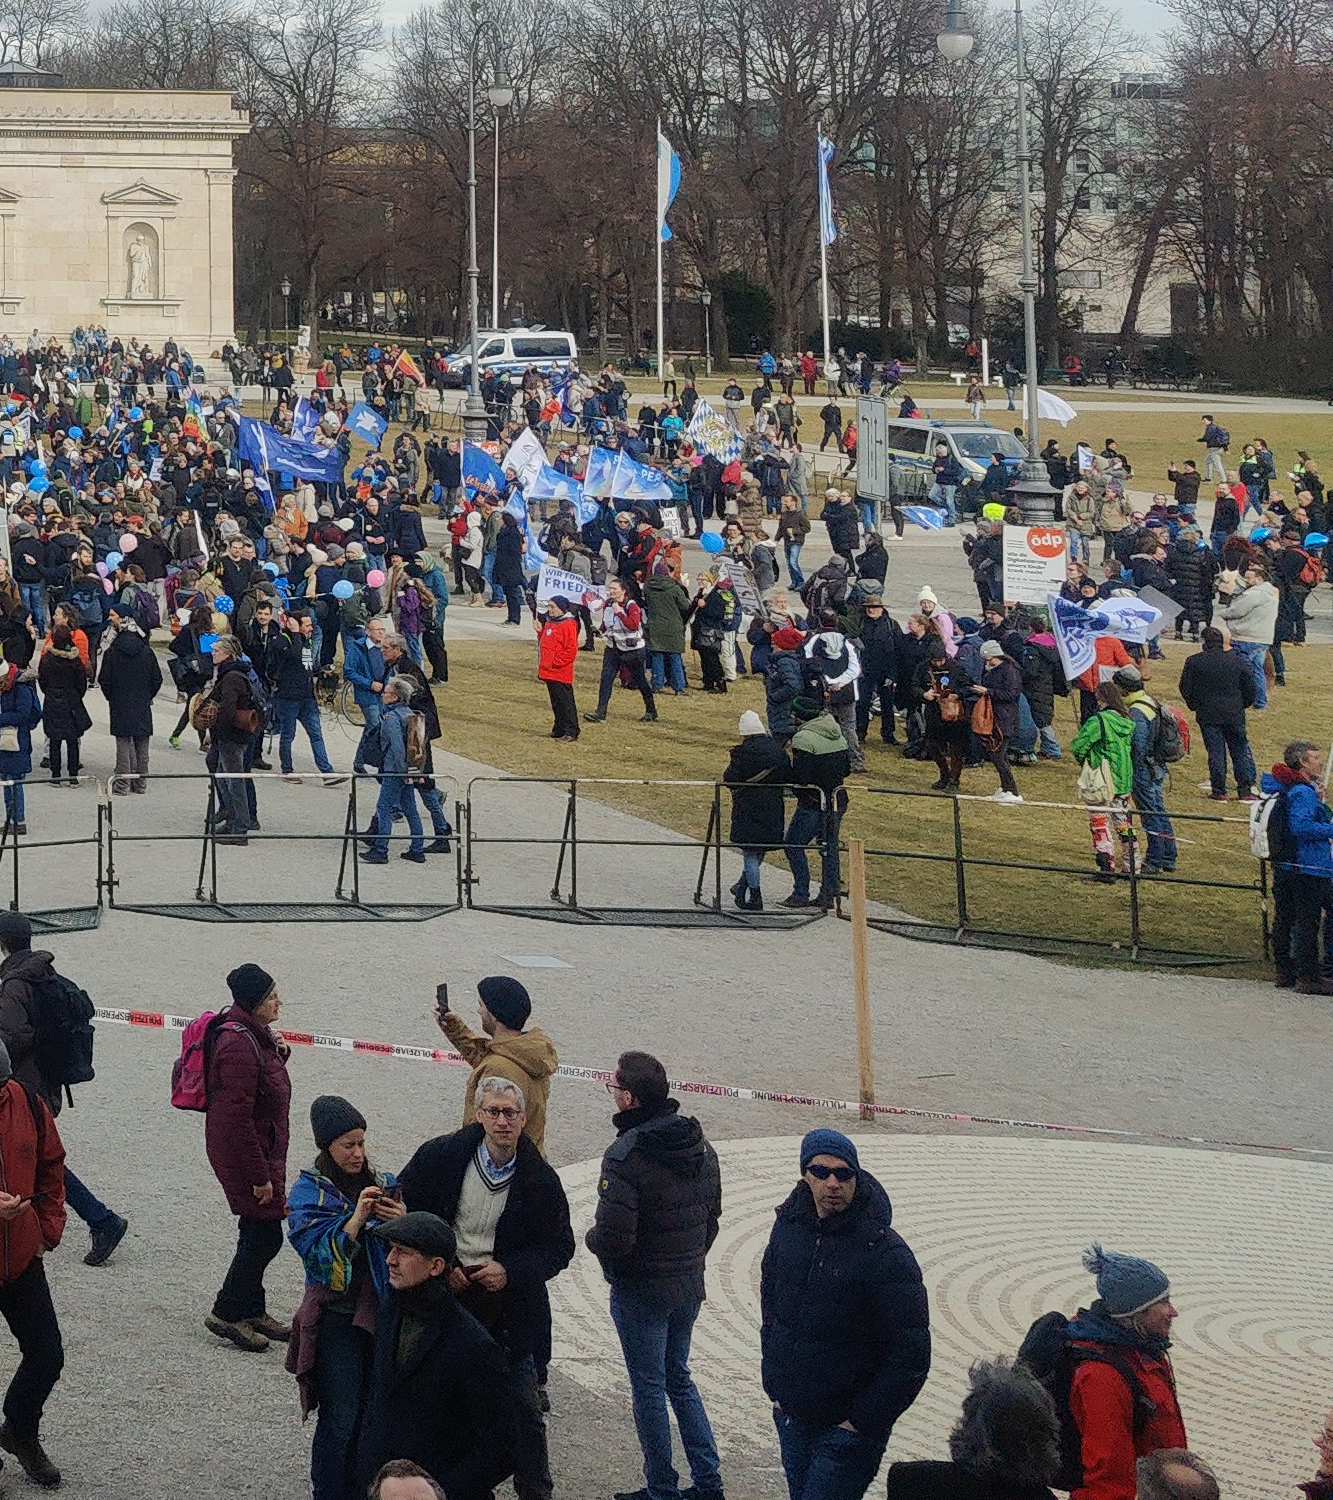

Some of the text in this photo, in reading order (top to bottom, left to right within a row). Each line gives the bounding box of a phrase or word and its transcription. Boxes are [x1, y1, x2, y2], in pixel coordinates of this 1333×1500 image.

[1031, 532, 1062, 548] ödp
[545, 568, 563, 577] WIR
[94, 1010, 163, 1026] POLIZEIABSPERRU
[284, 1032, 342, 1047] POLIZEIABSPE
[558, 1066, 612, 1080] EIABSPERRU
[671, 1081, 741, 1098] POLIZEIABSPER
